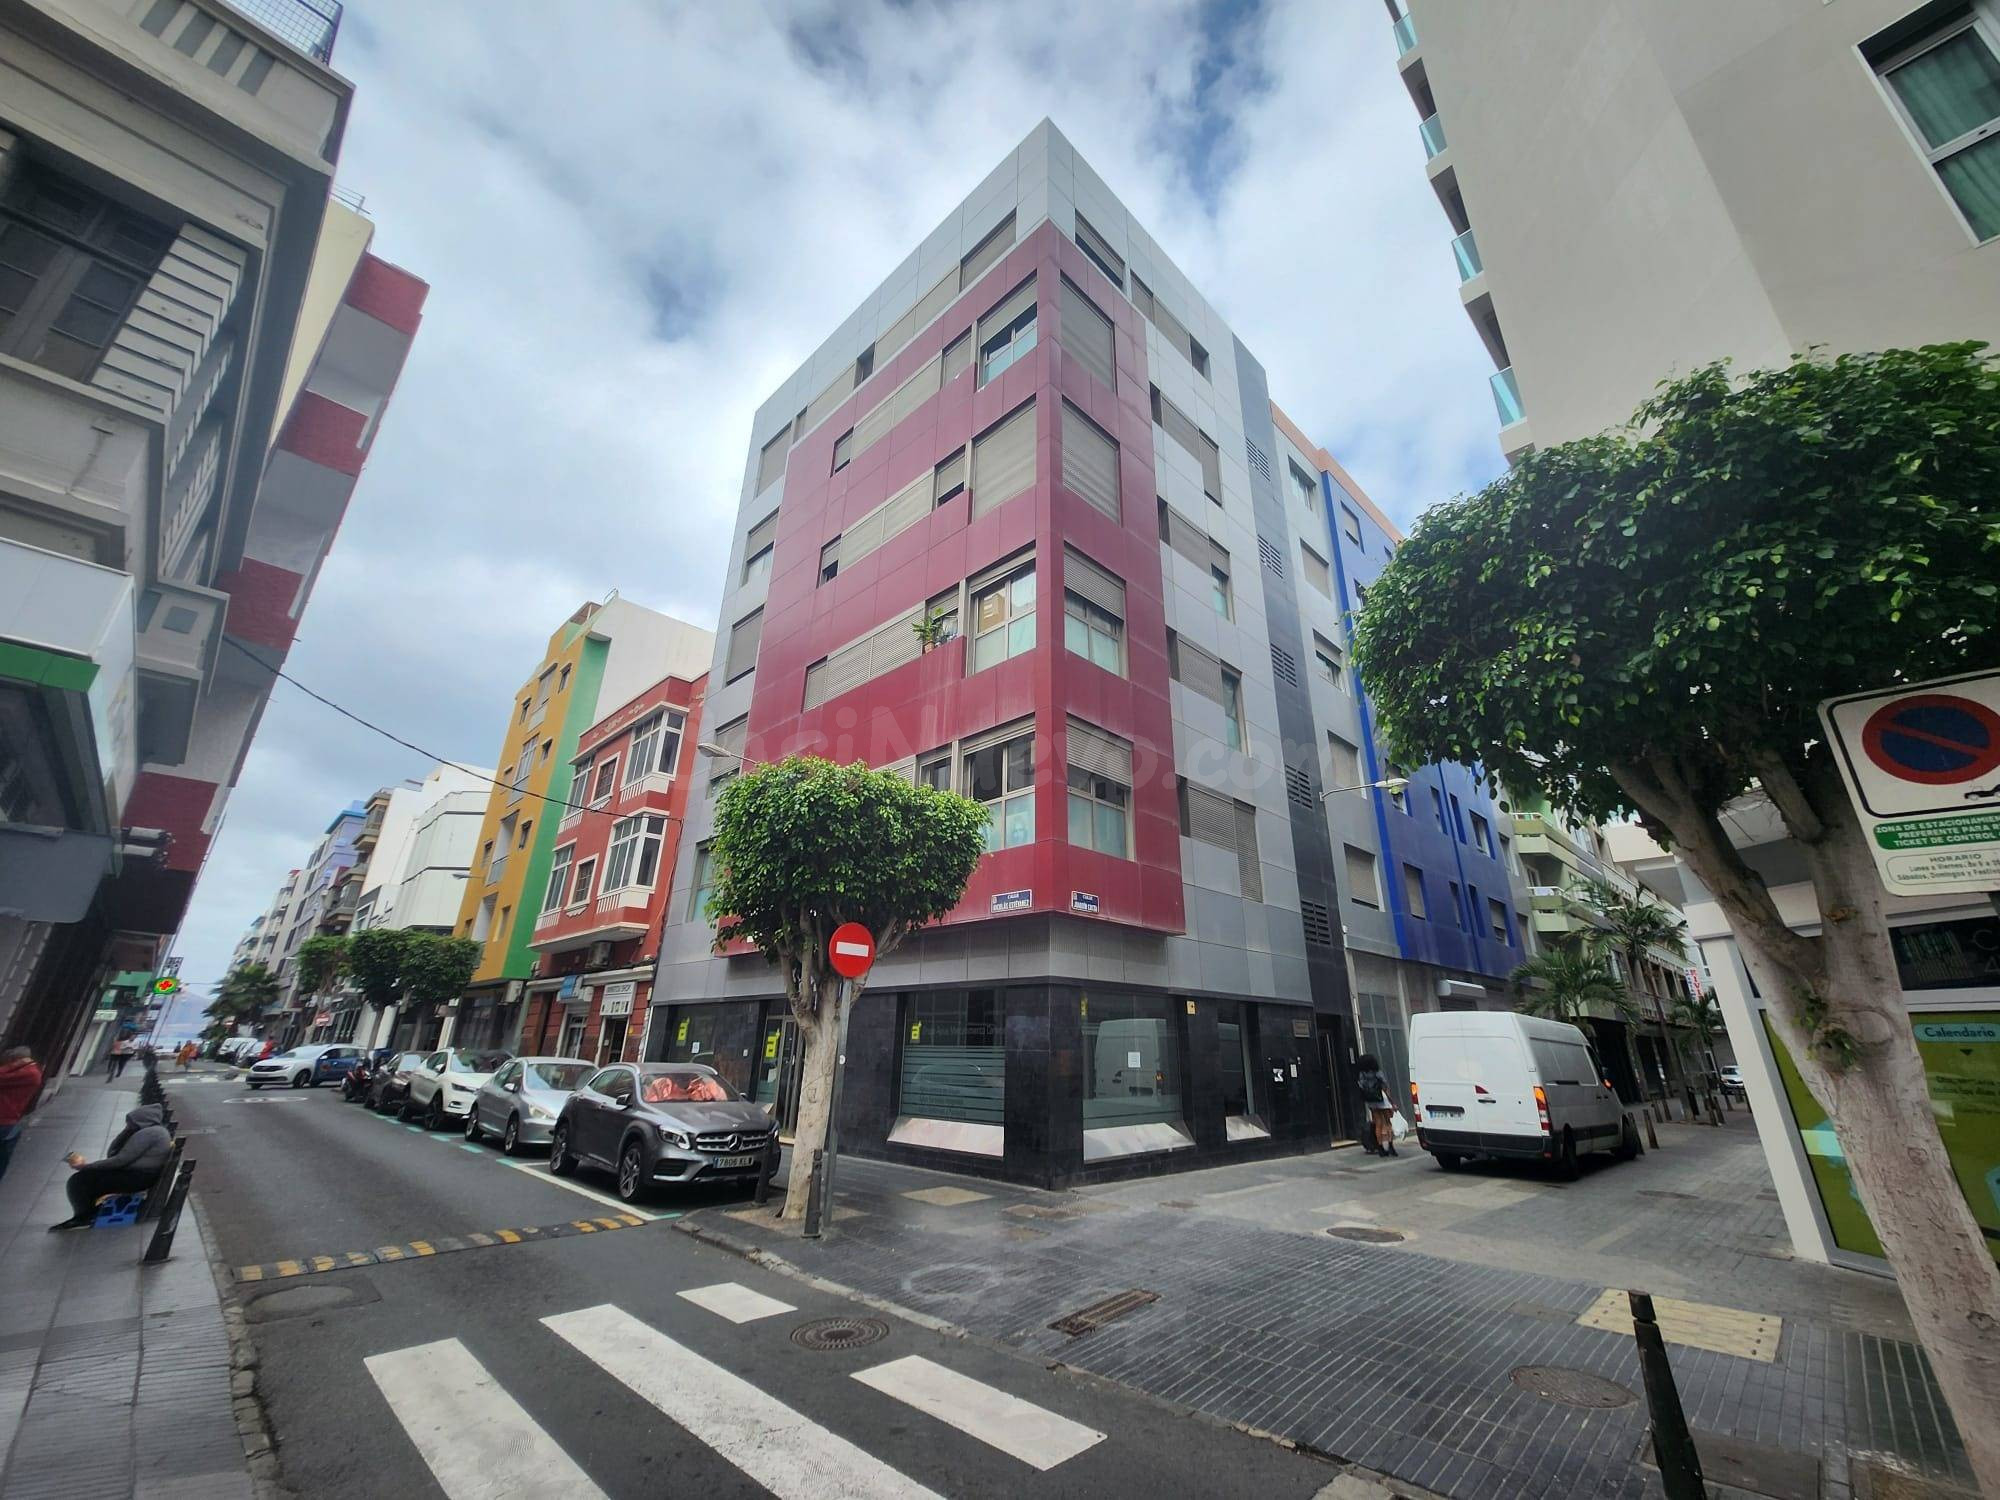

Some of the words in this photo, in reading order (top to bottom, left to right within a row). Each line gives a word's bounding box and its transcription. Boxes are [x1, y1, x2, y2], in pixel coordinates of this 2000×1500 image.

[1876, 825, 1903, 833] ZONA
[1903, 823, 1916, 831] DE
[1897, 827, 1960, 839] PREFERENTE
[1962, 824, 1991, 833] PARA
[1894, 838, 1929, 847] TICKET
[1930, 836, 1945, 844] DE
[1946, 832, 1996, 842] CONTROL
[1929, 853, 1982, 863] HORARIO
[1924, 1026, 1996, 1038] Calendario
